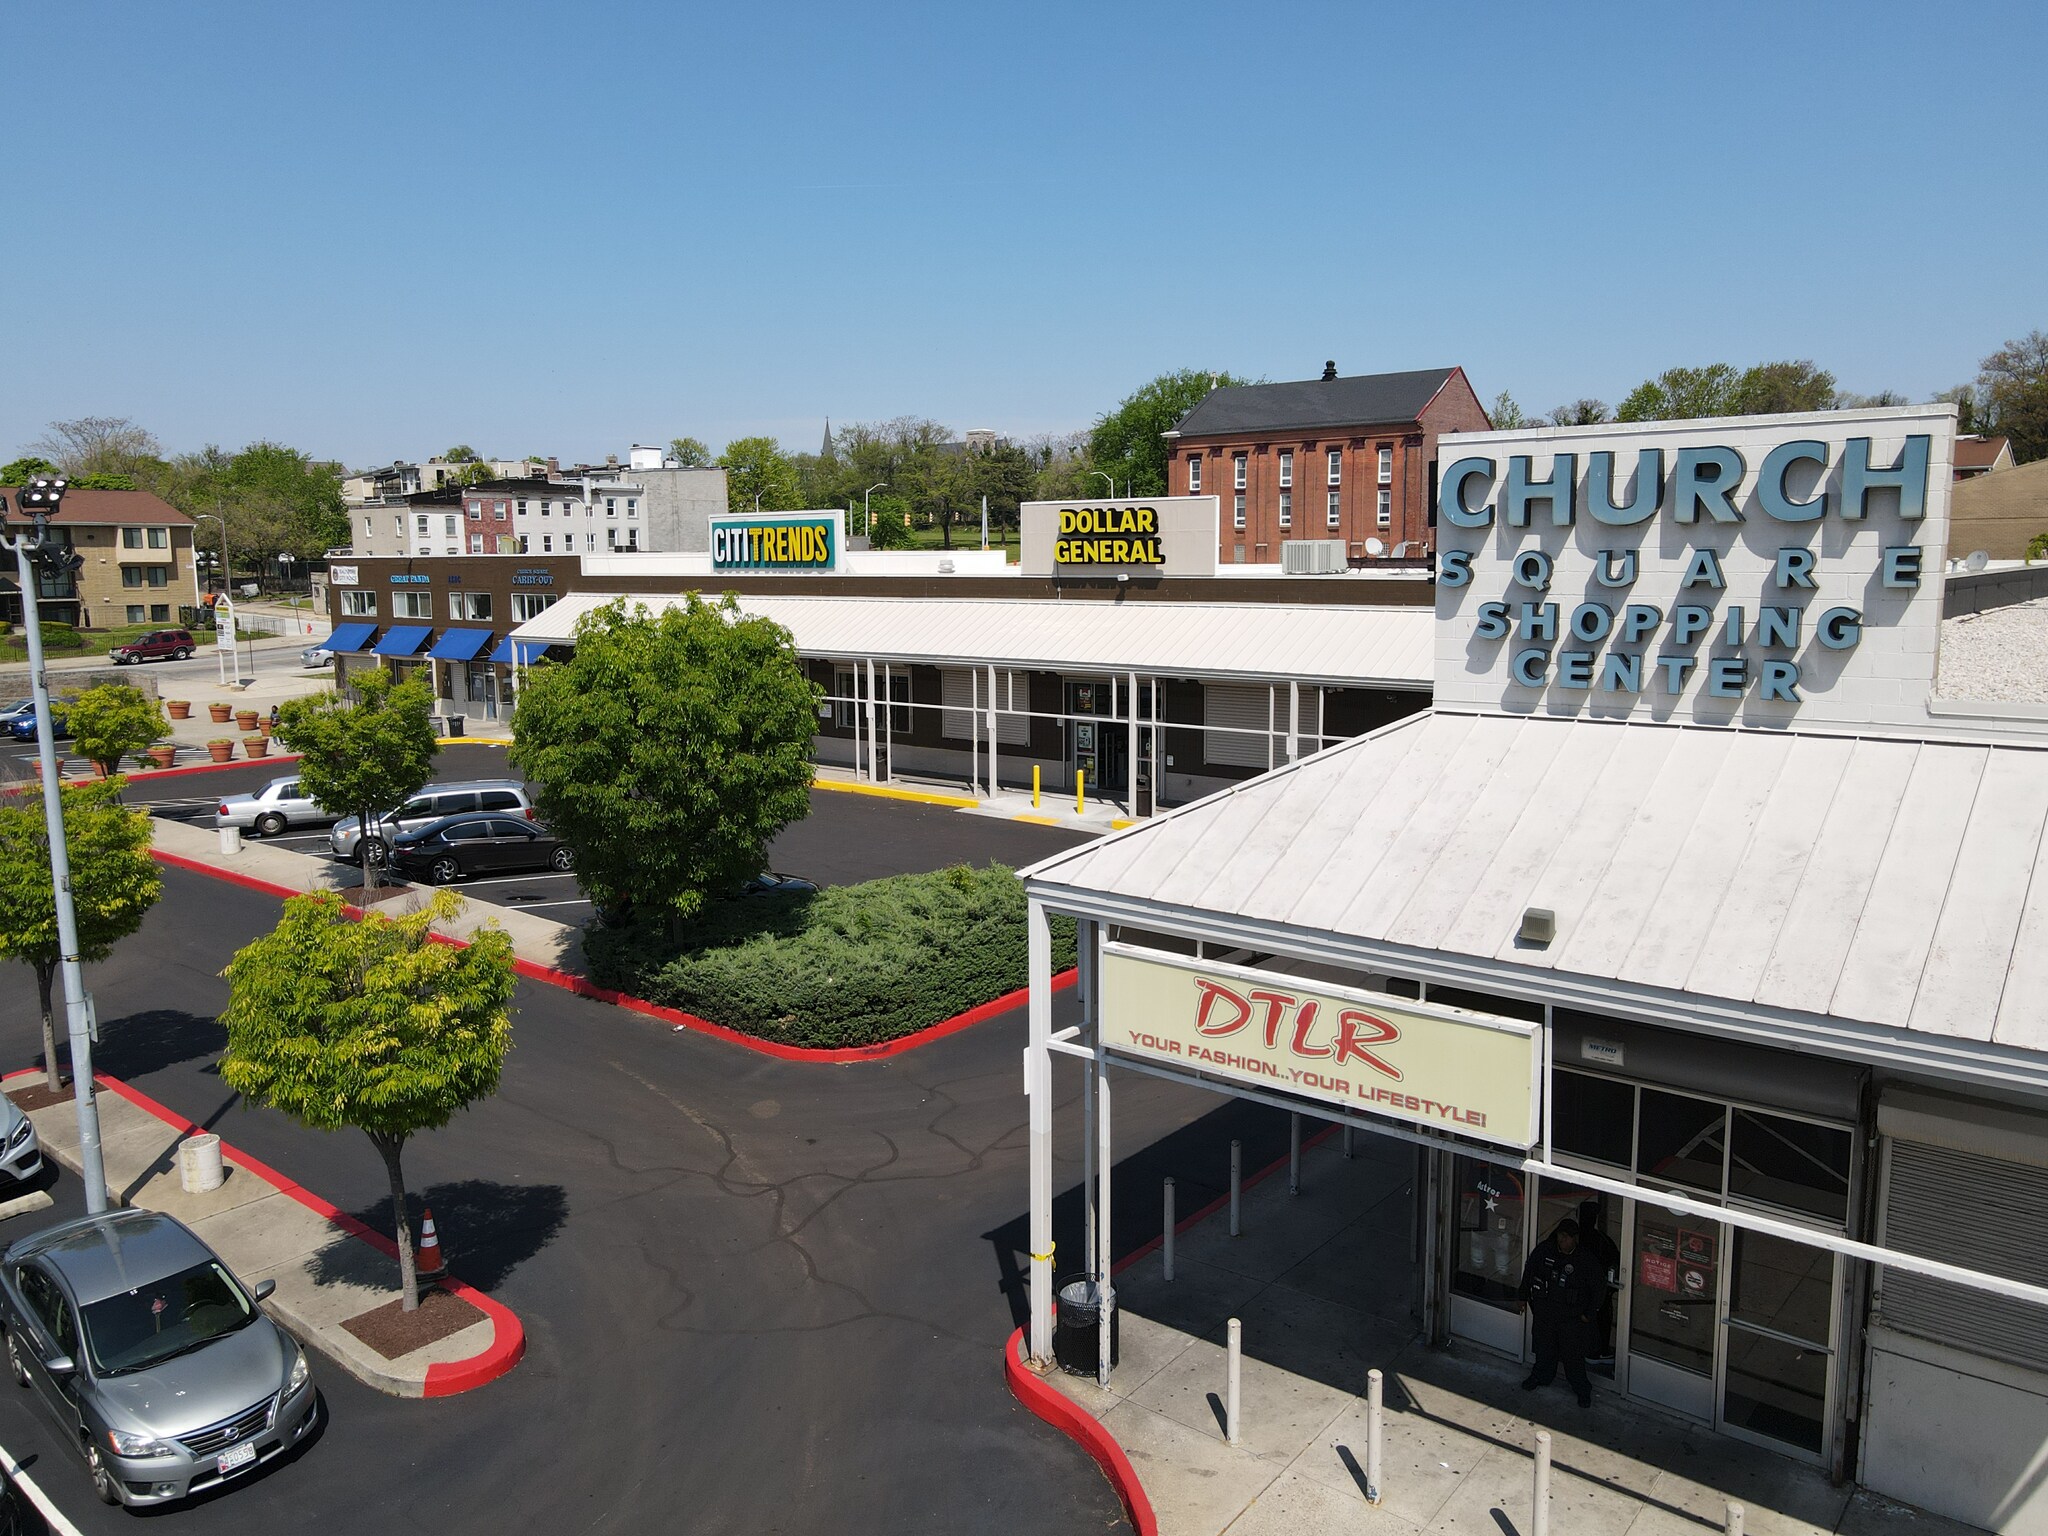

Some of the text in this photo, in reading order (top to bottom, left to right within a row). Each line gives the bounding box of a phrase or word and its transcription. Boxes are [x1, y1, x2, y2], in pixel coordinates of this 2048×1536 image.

[1440, 433, 1932, 528] CHURCH
[1059, 508, 1157, 534] DOLLAR
[1054, 538, 1164, 564] GENERAL
[1439, 546, 1922, 592] SQUARE
[512, 575, 554, 585] CARRY-OUT
[1476, 601, 1863, 649] SHOPPING
[1512, 649, 1801, 702] CENTER
[1194, 976, 1404, 1082] DTLR
[1129, 1030, 1182, 1055] YOUR
[1358, 1082, 1487, 1128] LIFESTYLE!
[1477, 1181, 1500, 1198] Astros
